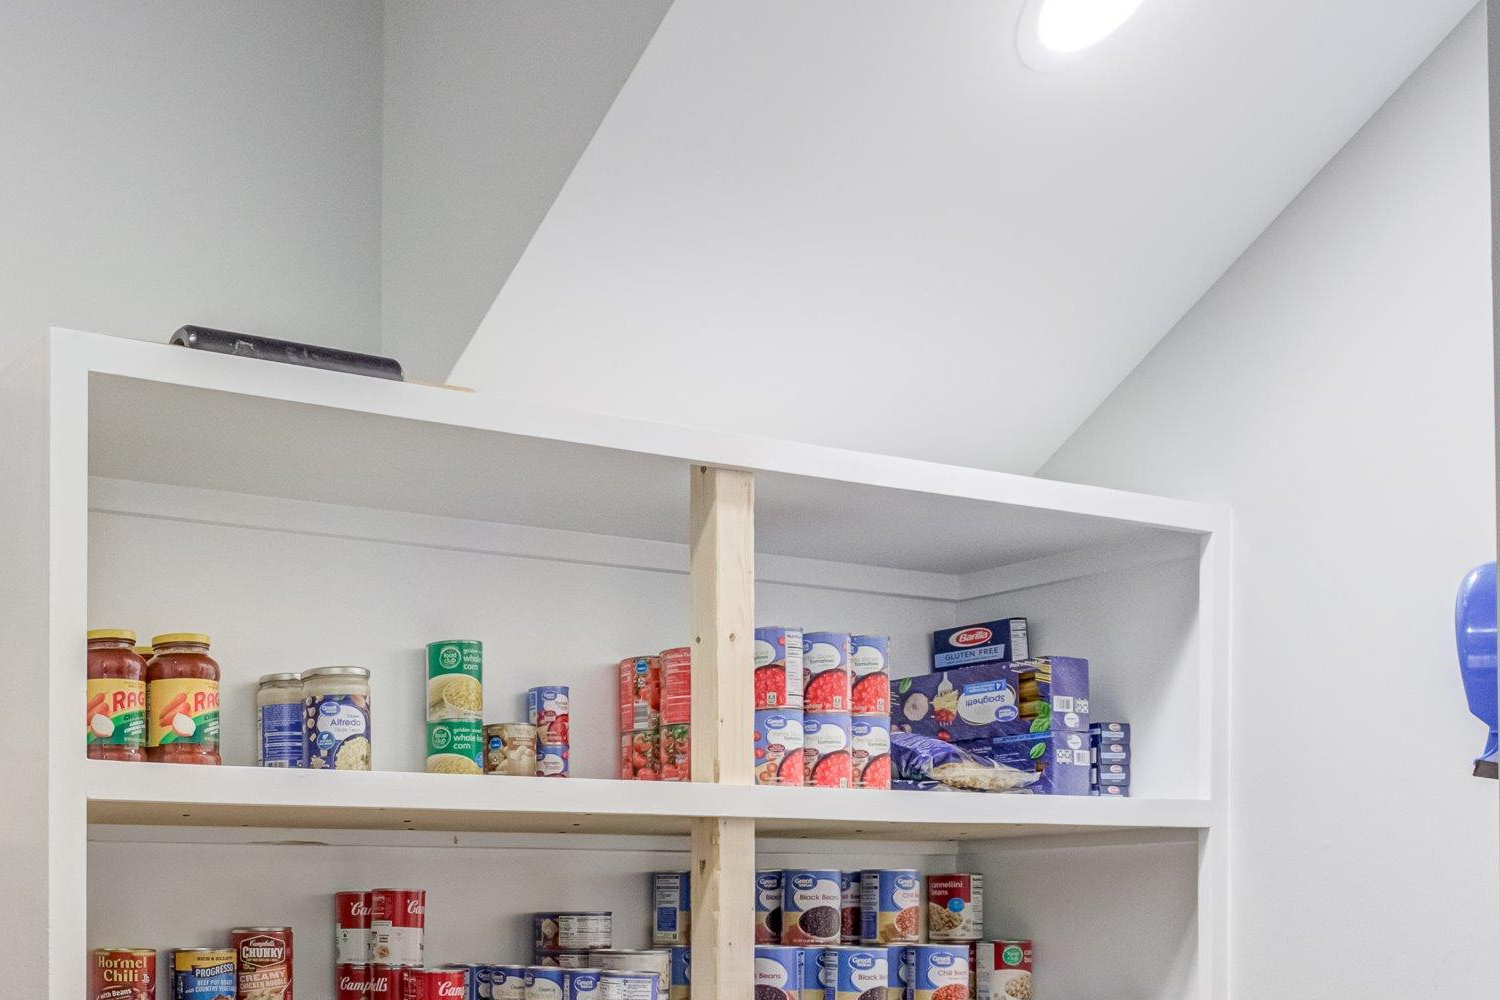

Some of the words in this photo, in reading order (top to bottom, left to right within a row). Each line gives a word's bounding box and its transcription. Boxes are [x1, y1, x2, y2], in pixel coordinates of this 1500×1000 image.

[959, 631, 988, 643] Barilla
[944, 651, 975, 661] GLUTEN
[978, 647, 999, 656] FREE
[112, 691, 145, 712] RAG
[192, 691, 220, 711] RAG
[965, 695, 1005, 707] Spaghetti
[243, 947, 283, 958] CHUNKY
[99, 956, 147, 968] Hormel
[104, 969, 139, 981] Chili
[195, 963, 234, 977] PROGRESSO
[240, 971, 285, 982] CREAMY
[112, 989, 132, 997] Beans
